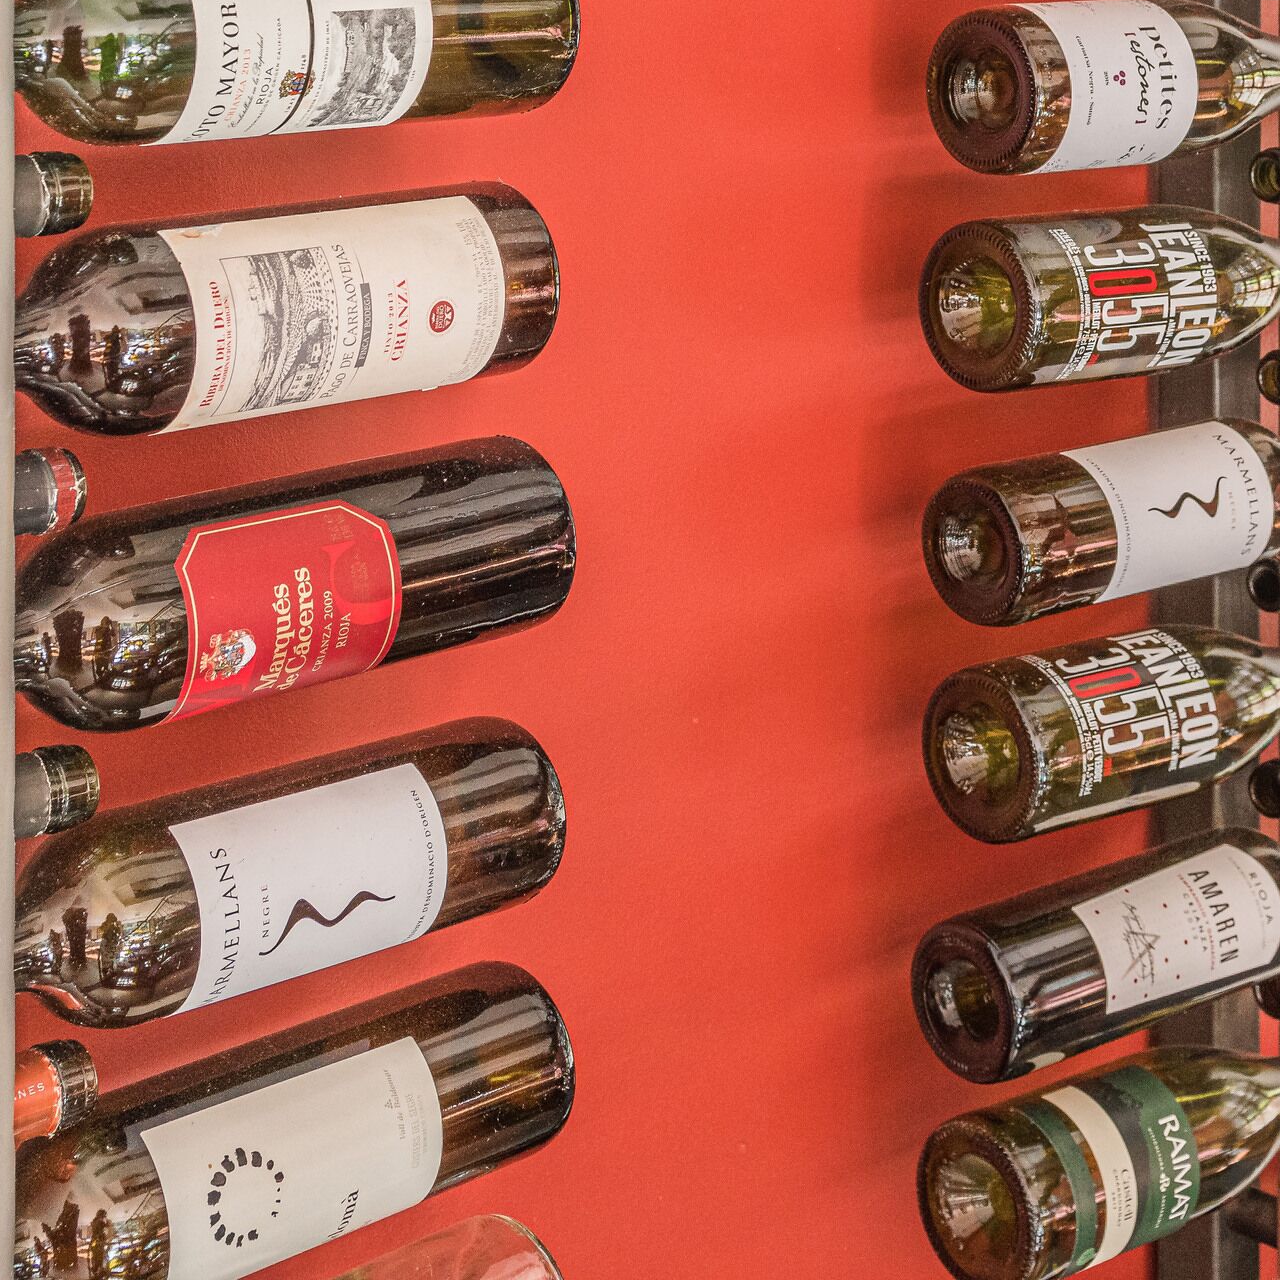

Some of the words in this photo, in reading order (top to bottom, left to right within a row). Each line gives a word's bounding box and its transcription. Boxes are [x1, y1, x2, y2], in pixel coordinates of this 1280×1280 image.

[214, 1, 240, 95] MAYOR
[221, 78, 249, 121] CRIANZA
[240, 47, 252, 76] 2013
[254, 65, 274, 105] RIOJA
[1137, 25, 1178, 129] petites
[1183, 229, 1211, 261] SINCE
[1199, 262, 1216, 292] 1963
[207, 280, 225, 330] DUERO
[330, 243, 359, 347] CARRAOVEJAS
[362, 291, 371, 328] BODEGA
[386, 291, 395, 317] 2013
[389, 278, 409, 361] CRIANZA
[1092, 301, 1100, 329] MERLOT
[214, 333, 225, 361] DEL
[339, 350, 354, 369] DE
[358, 336, 370, 360] FINCA
[382, 321, 393, 353] TINTO
[198, 365, 223, 408] RIBERA
[319, 372, 347, 399] PAGO
[1211, 433, 1257, 556] MARMELLANS
[250, 582, 295, 694] Marqués
[283, 566, 314, 674] Cáceres
[310, 621, 333, 672] CRIANZA
[322, 589, 334, 619] 2009
[334, 611, 351, 648] RIOJA
[274, 672, 300, 691] de
[409, 788, 432, 836] D'ORIGEN
[420, 840, 436, 912] DENOMINACIO
[260, 882, 271, 938] NEGRE
[1188, 871, 1239, 963] AMAREN
[396, 1122, 406, 1140] Vall
[1157, 1113, 1192, 1220] RAIMAT
